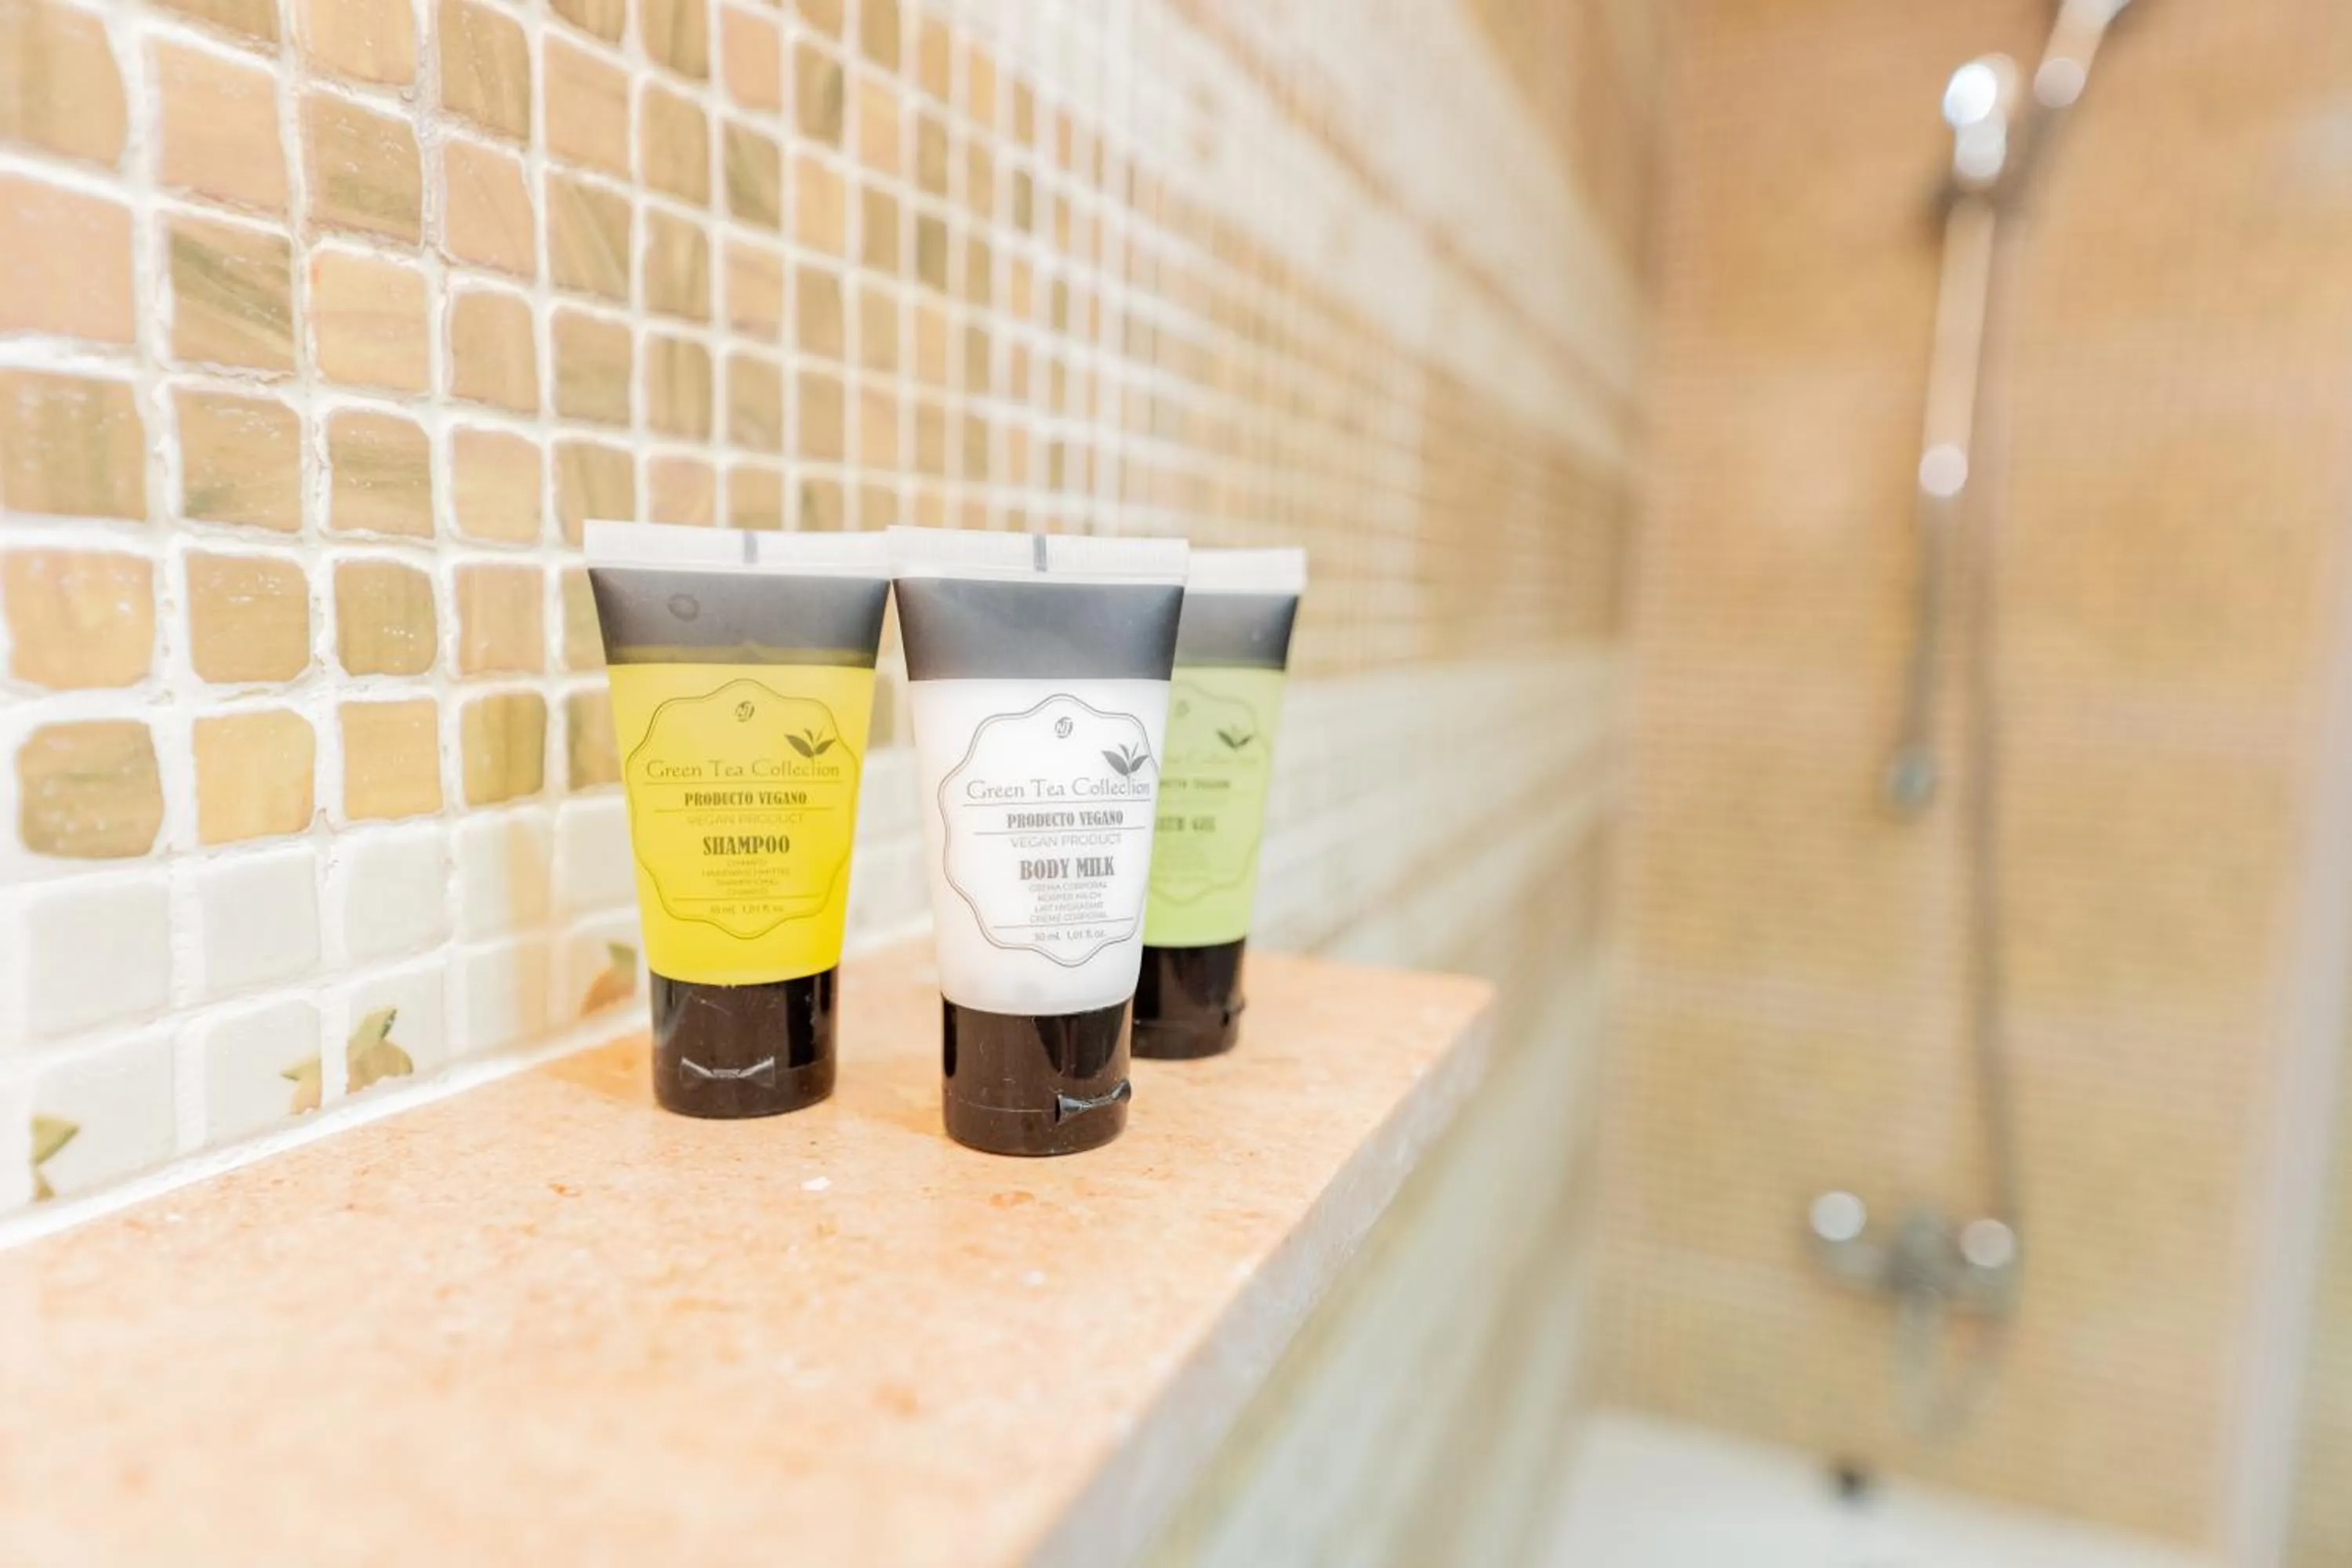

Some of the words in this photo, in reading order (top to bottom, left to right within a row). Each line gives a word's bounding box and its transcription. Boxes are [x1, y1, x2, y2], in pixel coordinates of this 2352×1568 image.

[646, 760, 702, 778] Green
[707, 760, 744, 777] Tea
[751, 758, 840, 778] Collection
[966, 779, 1025, 800] Green
[1029, 778, 1066, 797] Tea
[1071, 776, 1151, 797] Collection
[684, 792, 753, 807] PRODUCTO
[759, 791, 807, 805] VEGANO
[1007, 812, 1075, 829] PRODUCTO
[1080, 810, 1124, 826] VEGANO
[702, 834, 790, 856] SHAMPOO
[1009, 836, 1058, 848] VEGAN
[1061, 833, 1122, 847] PRODUCT
[1018, 858, 1071, 880] BODY
[1076, 855, 1115, 879] MILK
